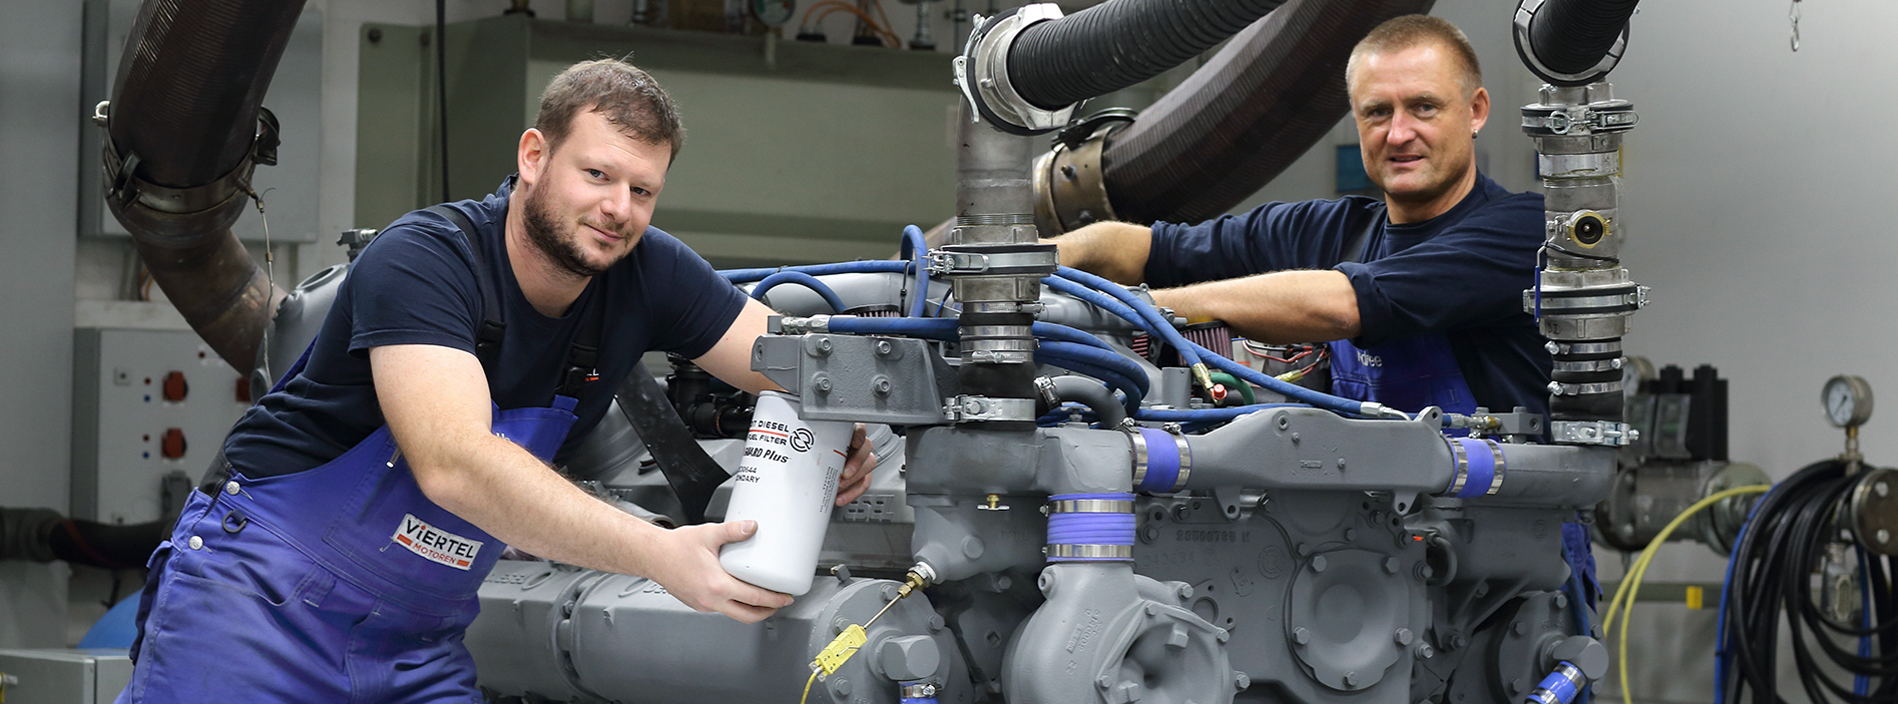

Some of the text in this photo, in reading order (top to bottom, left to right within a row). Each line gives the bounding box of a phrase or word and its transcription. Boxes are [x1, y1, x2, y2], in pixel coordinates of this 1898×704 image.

[758, 420, 789, 433] DIESEL
[760, 434, 787, 446] FILTER
[763, 449, 789, 463] Plus
[413, 543, 457, 564] MOTOREN
